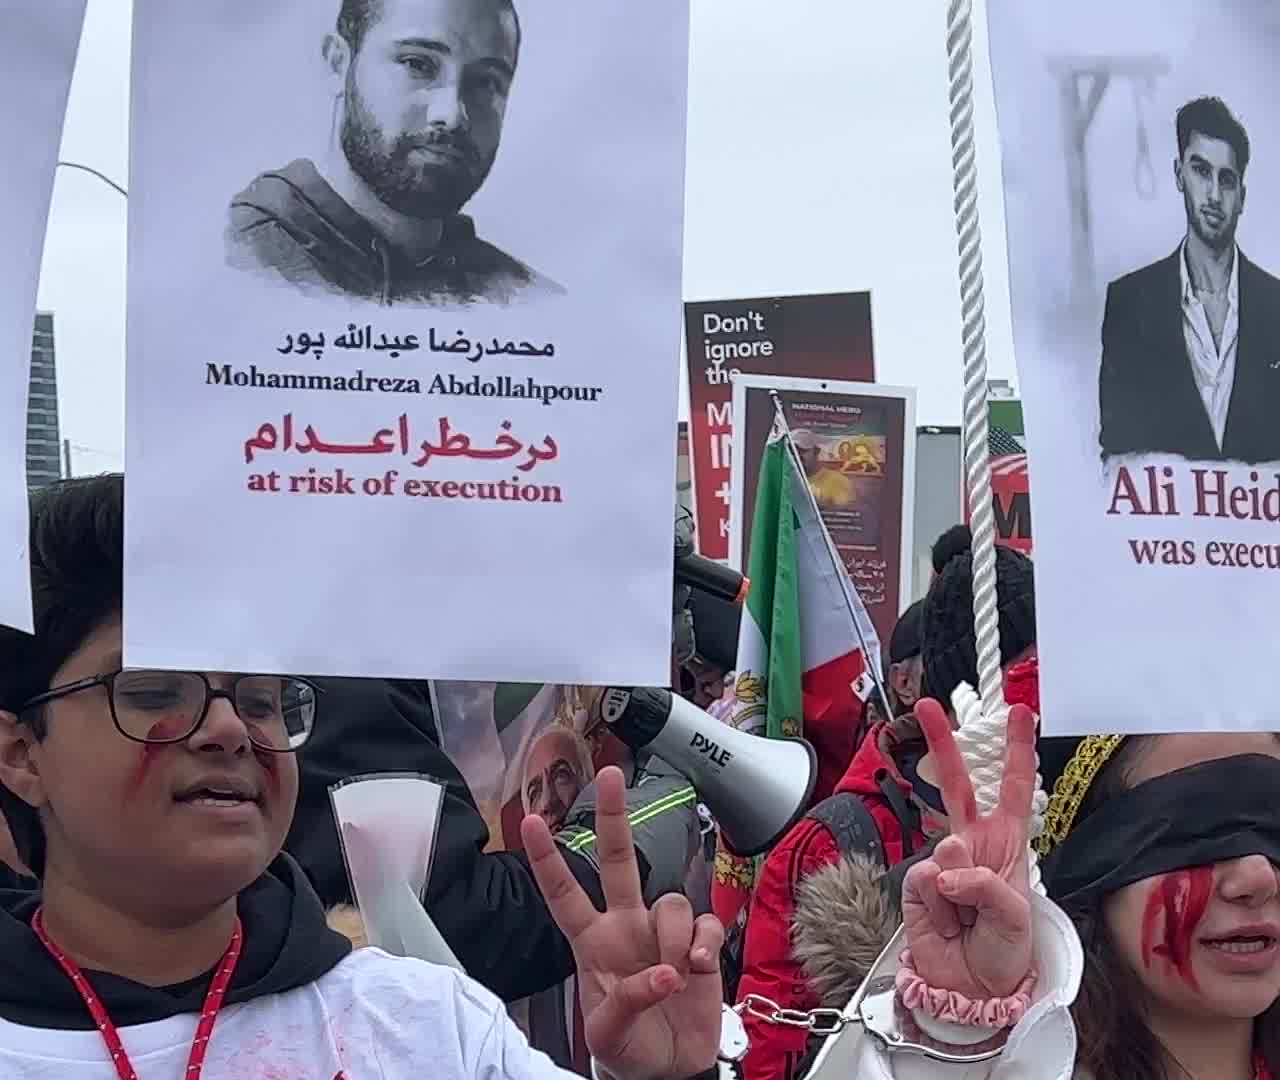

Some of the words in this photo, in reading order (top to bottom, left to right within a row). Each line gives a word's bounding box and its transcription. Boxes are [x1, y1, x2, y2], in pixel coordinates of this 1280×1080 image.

[703, 310, 765, 334] Don't
[276, 329, 327, 360] پور
[332, 323, 421, 358] عبدالله
[428, 327, 556, 363] محمدرضا
[704, 338, 774, 364] ignore
[205, 362, 421, 394] Mohammadreza
[426, 372, 603, 406] Abdollahpour
[705, 361, 741, 385] the
[246, 471, 280, 494] at
[288, 467, 356, 497] risk
[362, 469, 400, 497] of
[402, 475, 564, 504] execution
[1106, 465, 1181, 517] Ali
[1128, 538, 1197, 566] was
